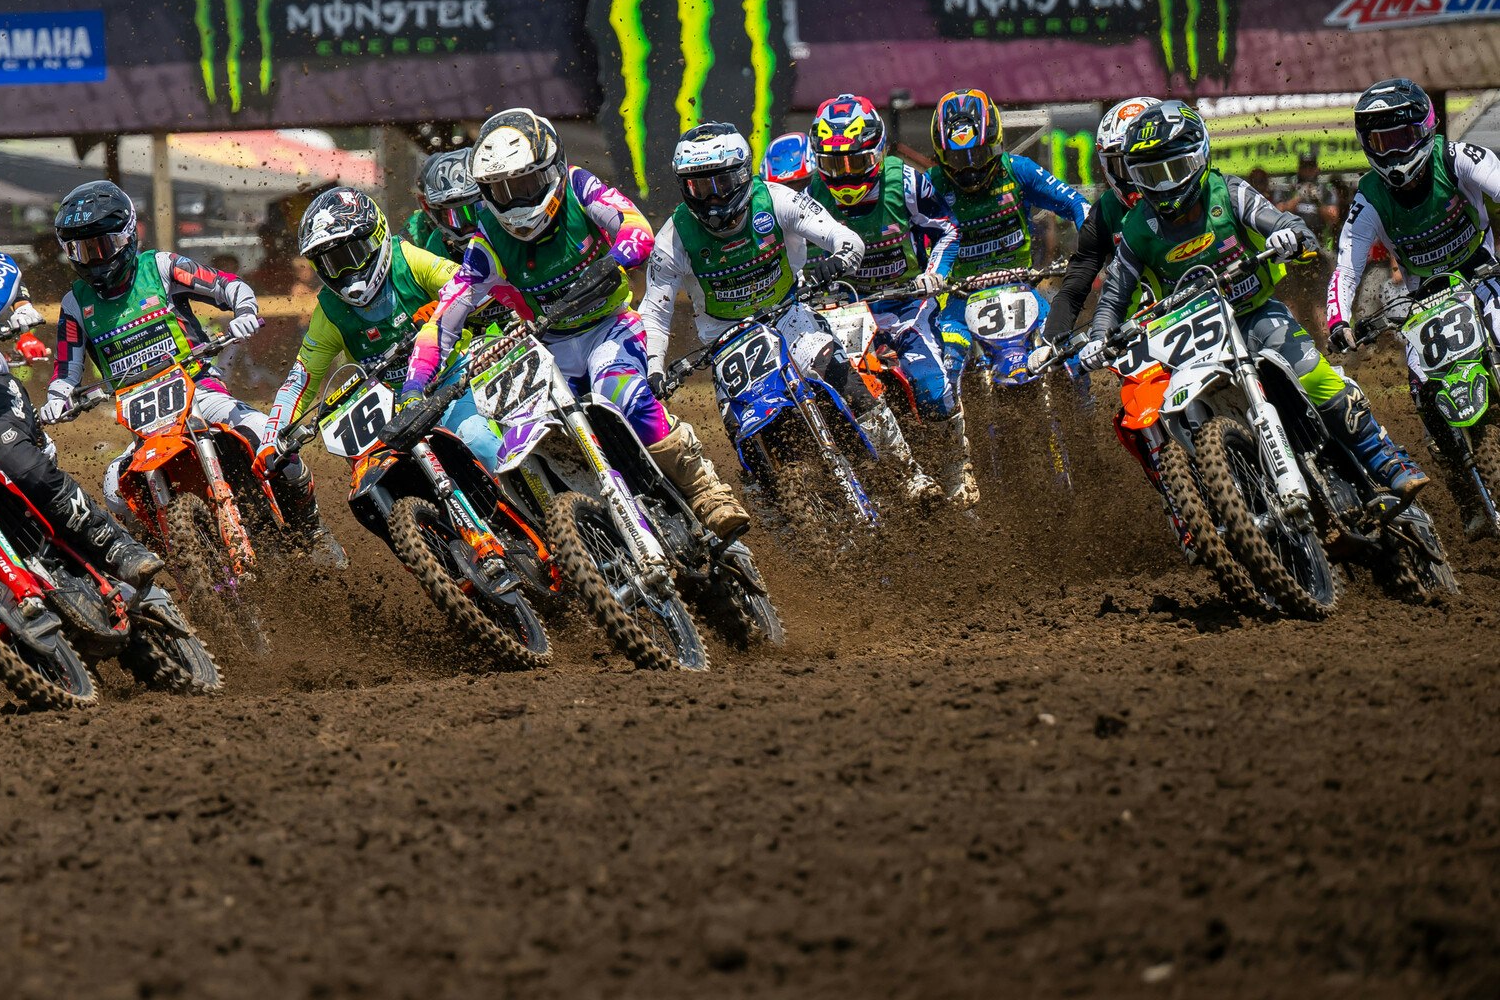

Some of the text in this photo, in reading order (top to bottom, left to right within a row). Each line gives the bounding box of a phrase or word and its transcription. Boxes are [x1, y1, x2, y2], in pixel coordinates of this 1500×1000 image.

[973, 15, 1111, 37] ENERGY
[316, 36, 458, 57] ENERGY
[1129, 139, 1162, 152] FLY
[62, 211, 92, 225] FLY
[1411, 225, 1477, 265] CHAMPIONSHIP
[977, 299, 1026, 336] 31
[122, 330, 149, 345] MONSTER
[1164, 306, 1225, 368] 25
[1420, 306, 1476, 368] 83
[111, 339, 174, 374] CHAMPIONSHIP
[722, 335, 780, 398] 92
[484, 350, 547, 420] 22
[129, 379, 187, 431] 60
[333, 391, 387, 457] 16
[449, 498, 475, 530] DUNLOP
